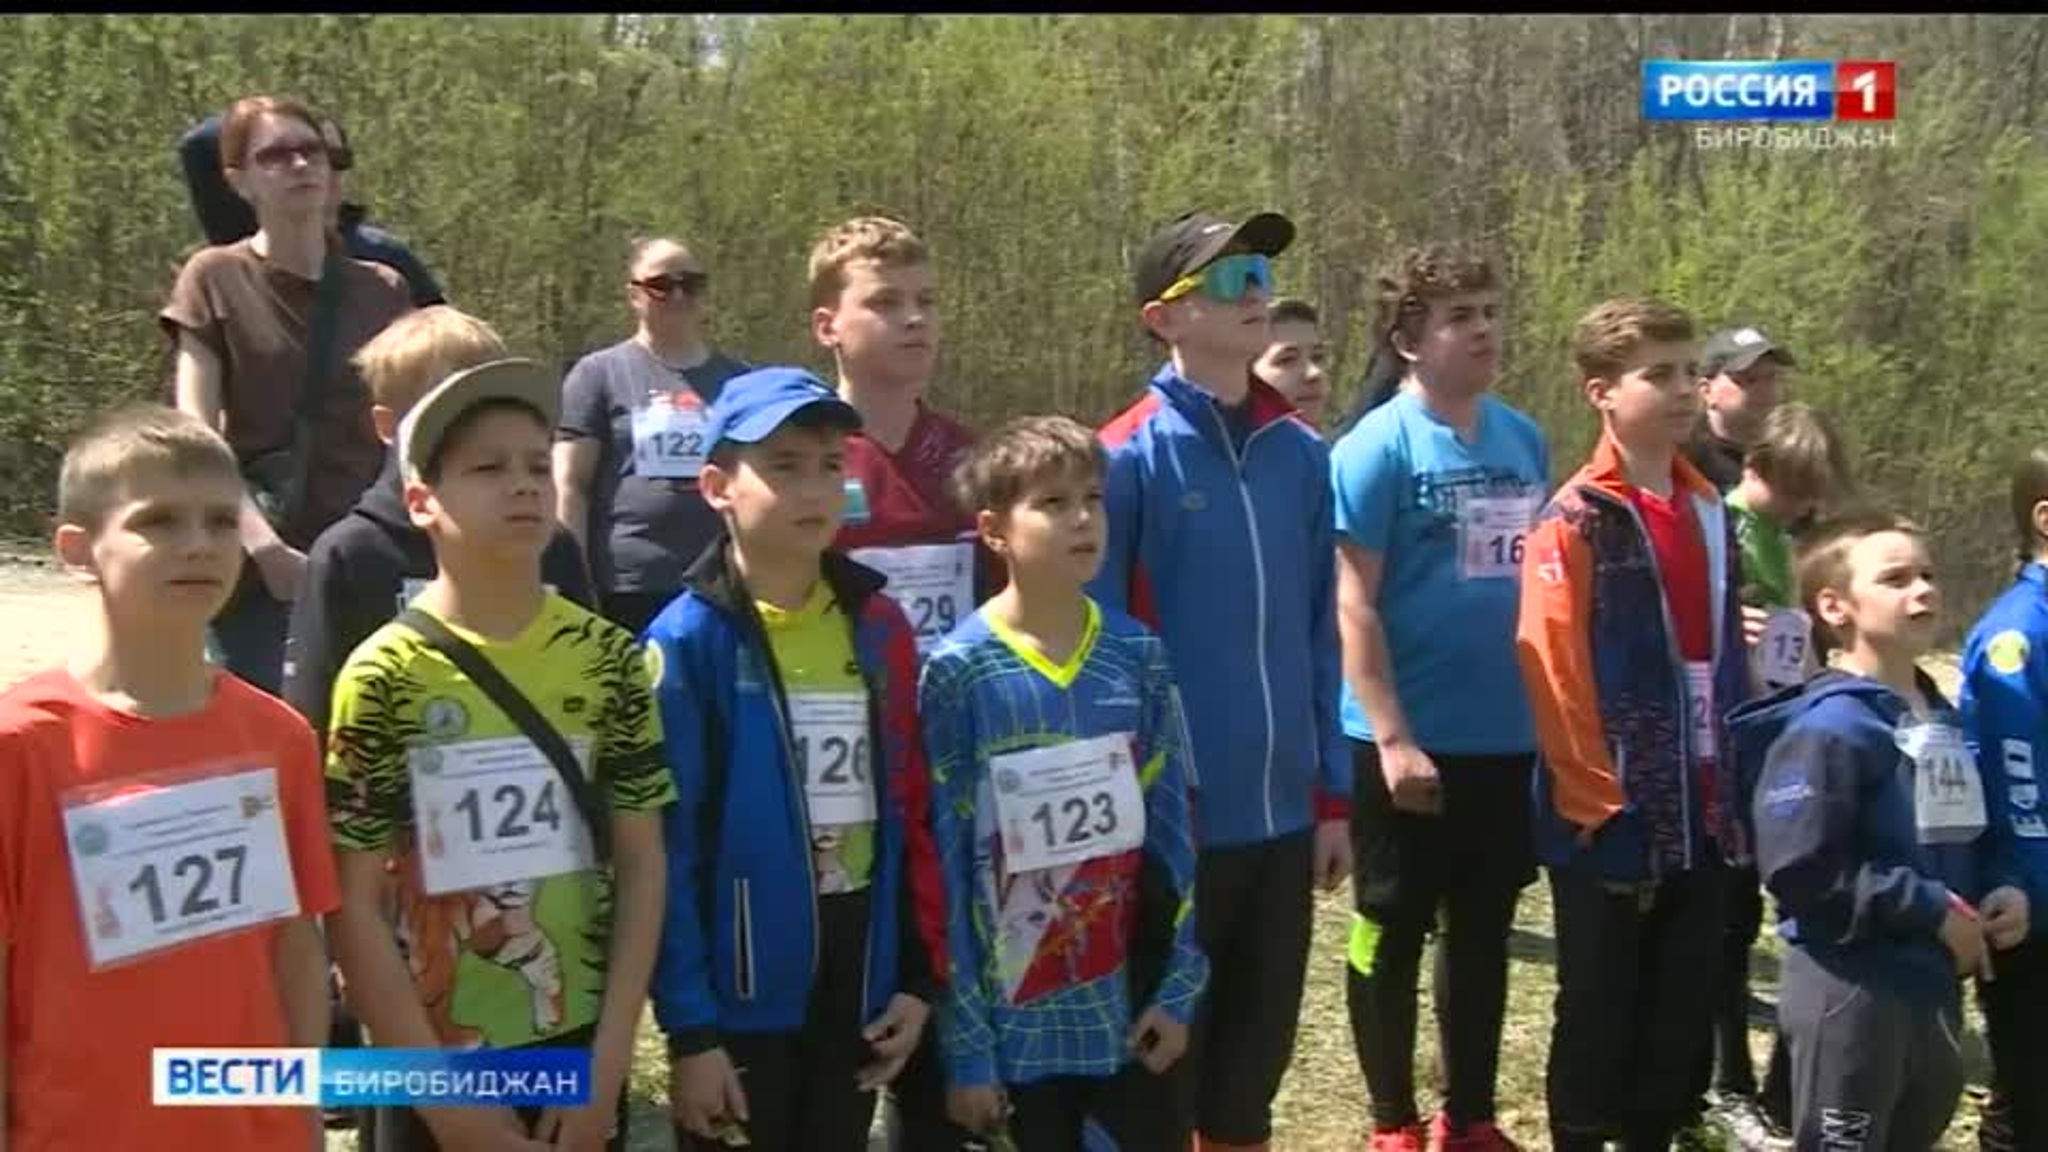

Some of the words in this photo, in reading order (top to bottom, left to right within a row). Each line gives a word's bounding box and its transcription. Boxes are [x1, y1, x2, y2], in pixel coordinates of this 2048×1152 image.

[649, 431, 703, 457] 122
[455, 780, 561, 842] 124
[1030, 791, 1118, 847] 123
[128, 844, 247, 924] 127
